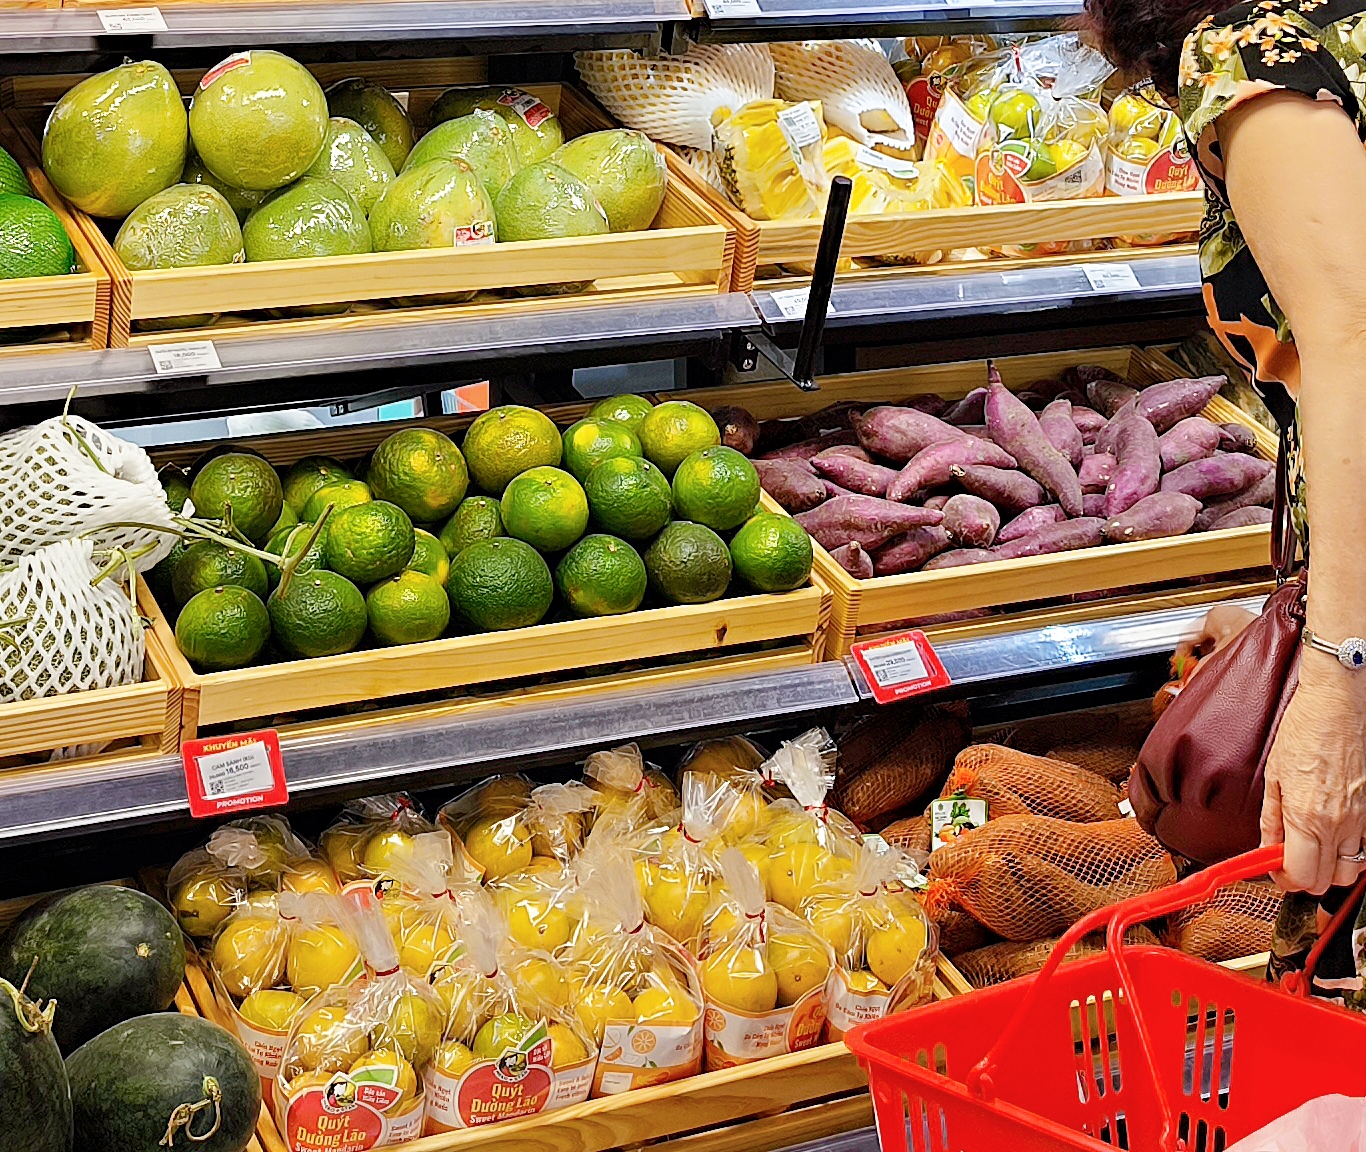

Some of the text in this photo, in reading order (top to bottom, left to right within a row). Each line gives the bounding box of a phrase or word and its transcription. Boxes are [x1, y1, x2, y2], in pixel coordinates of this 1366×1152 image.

[216, 794, 264, 809] PROMOTION
[492, 1082, 524, 1099] Quýt
[317, 1113, 350, 1132] Quýt
